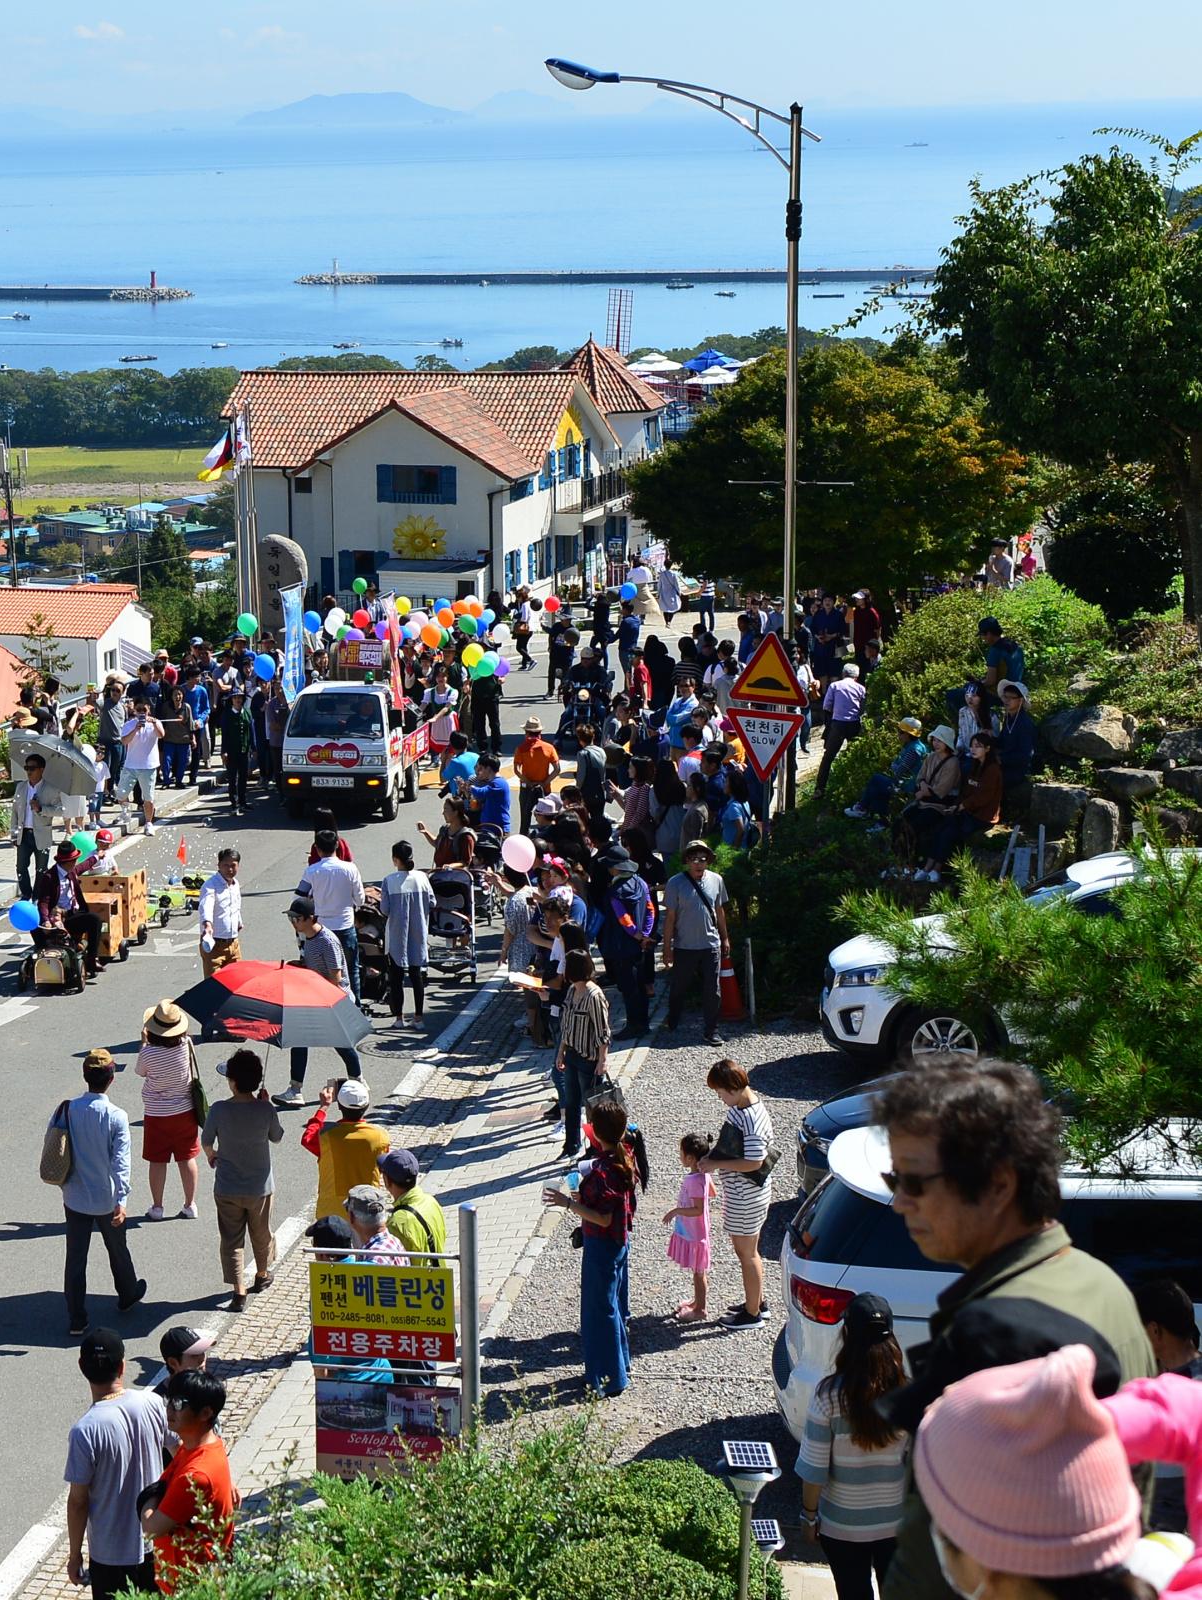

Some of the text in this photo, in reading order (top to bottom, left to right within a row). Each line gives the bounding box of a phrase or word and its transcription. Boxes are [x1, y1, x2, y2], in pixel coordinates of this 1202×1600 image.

[745, 720, 783, 736] 천천히
[751, 736, 776, 745] SLOW
[320, 1274, 346, 1290] 카페
[321, 1292, 347, 1308] 펜션
[352, 1275, 445, 1311] 베를린성
[328, 1332, 442, 1357] 전용주차장
[348, 1433, 429, 1448] Schloß Kffee
